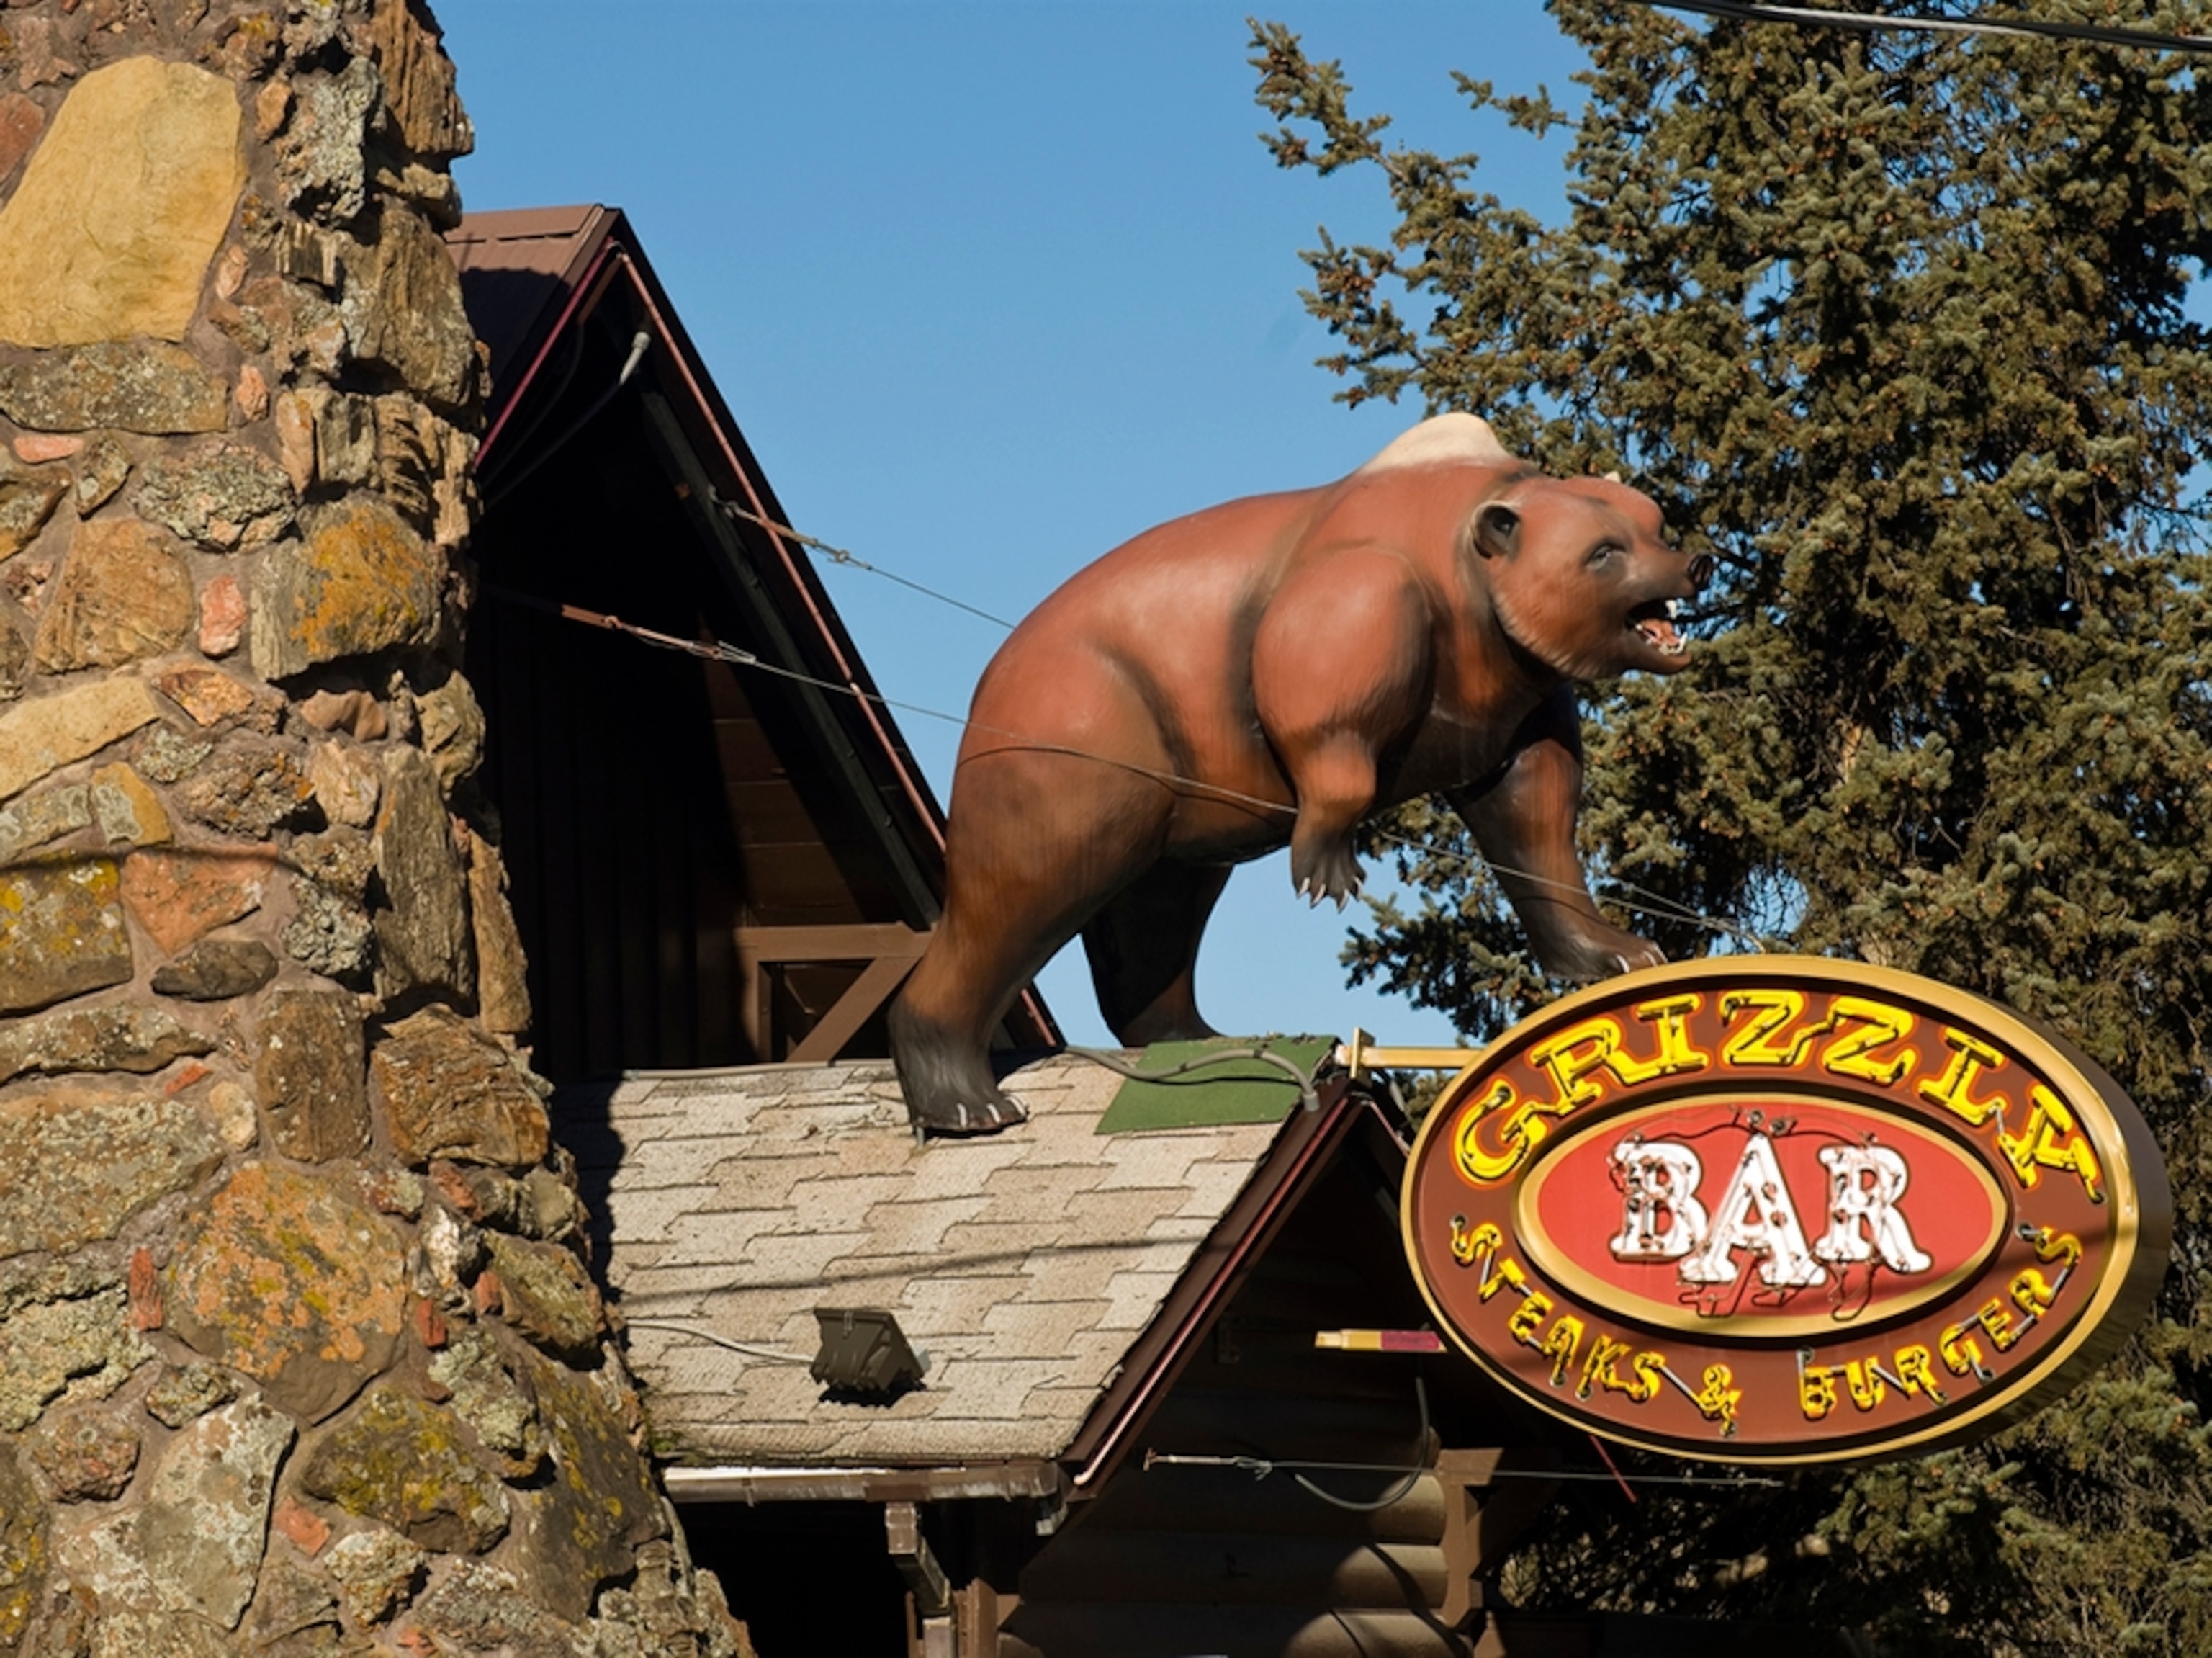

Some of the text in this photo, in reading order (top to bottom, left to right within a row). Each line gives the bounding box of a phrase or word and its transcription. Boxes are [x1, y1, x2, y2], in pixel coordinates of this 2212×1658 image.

[1455, 990, 2104, 1201] GRIZZLY
[1609, 1133, 1933, 1288] BAR
[1451, 1218, 2083, 1433] STEAKS & BURGERS
